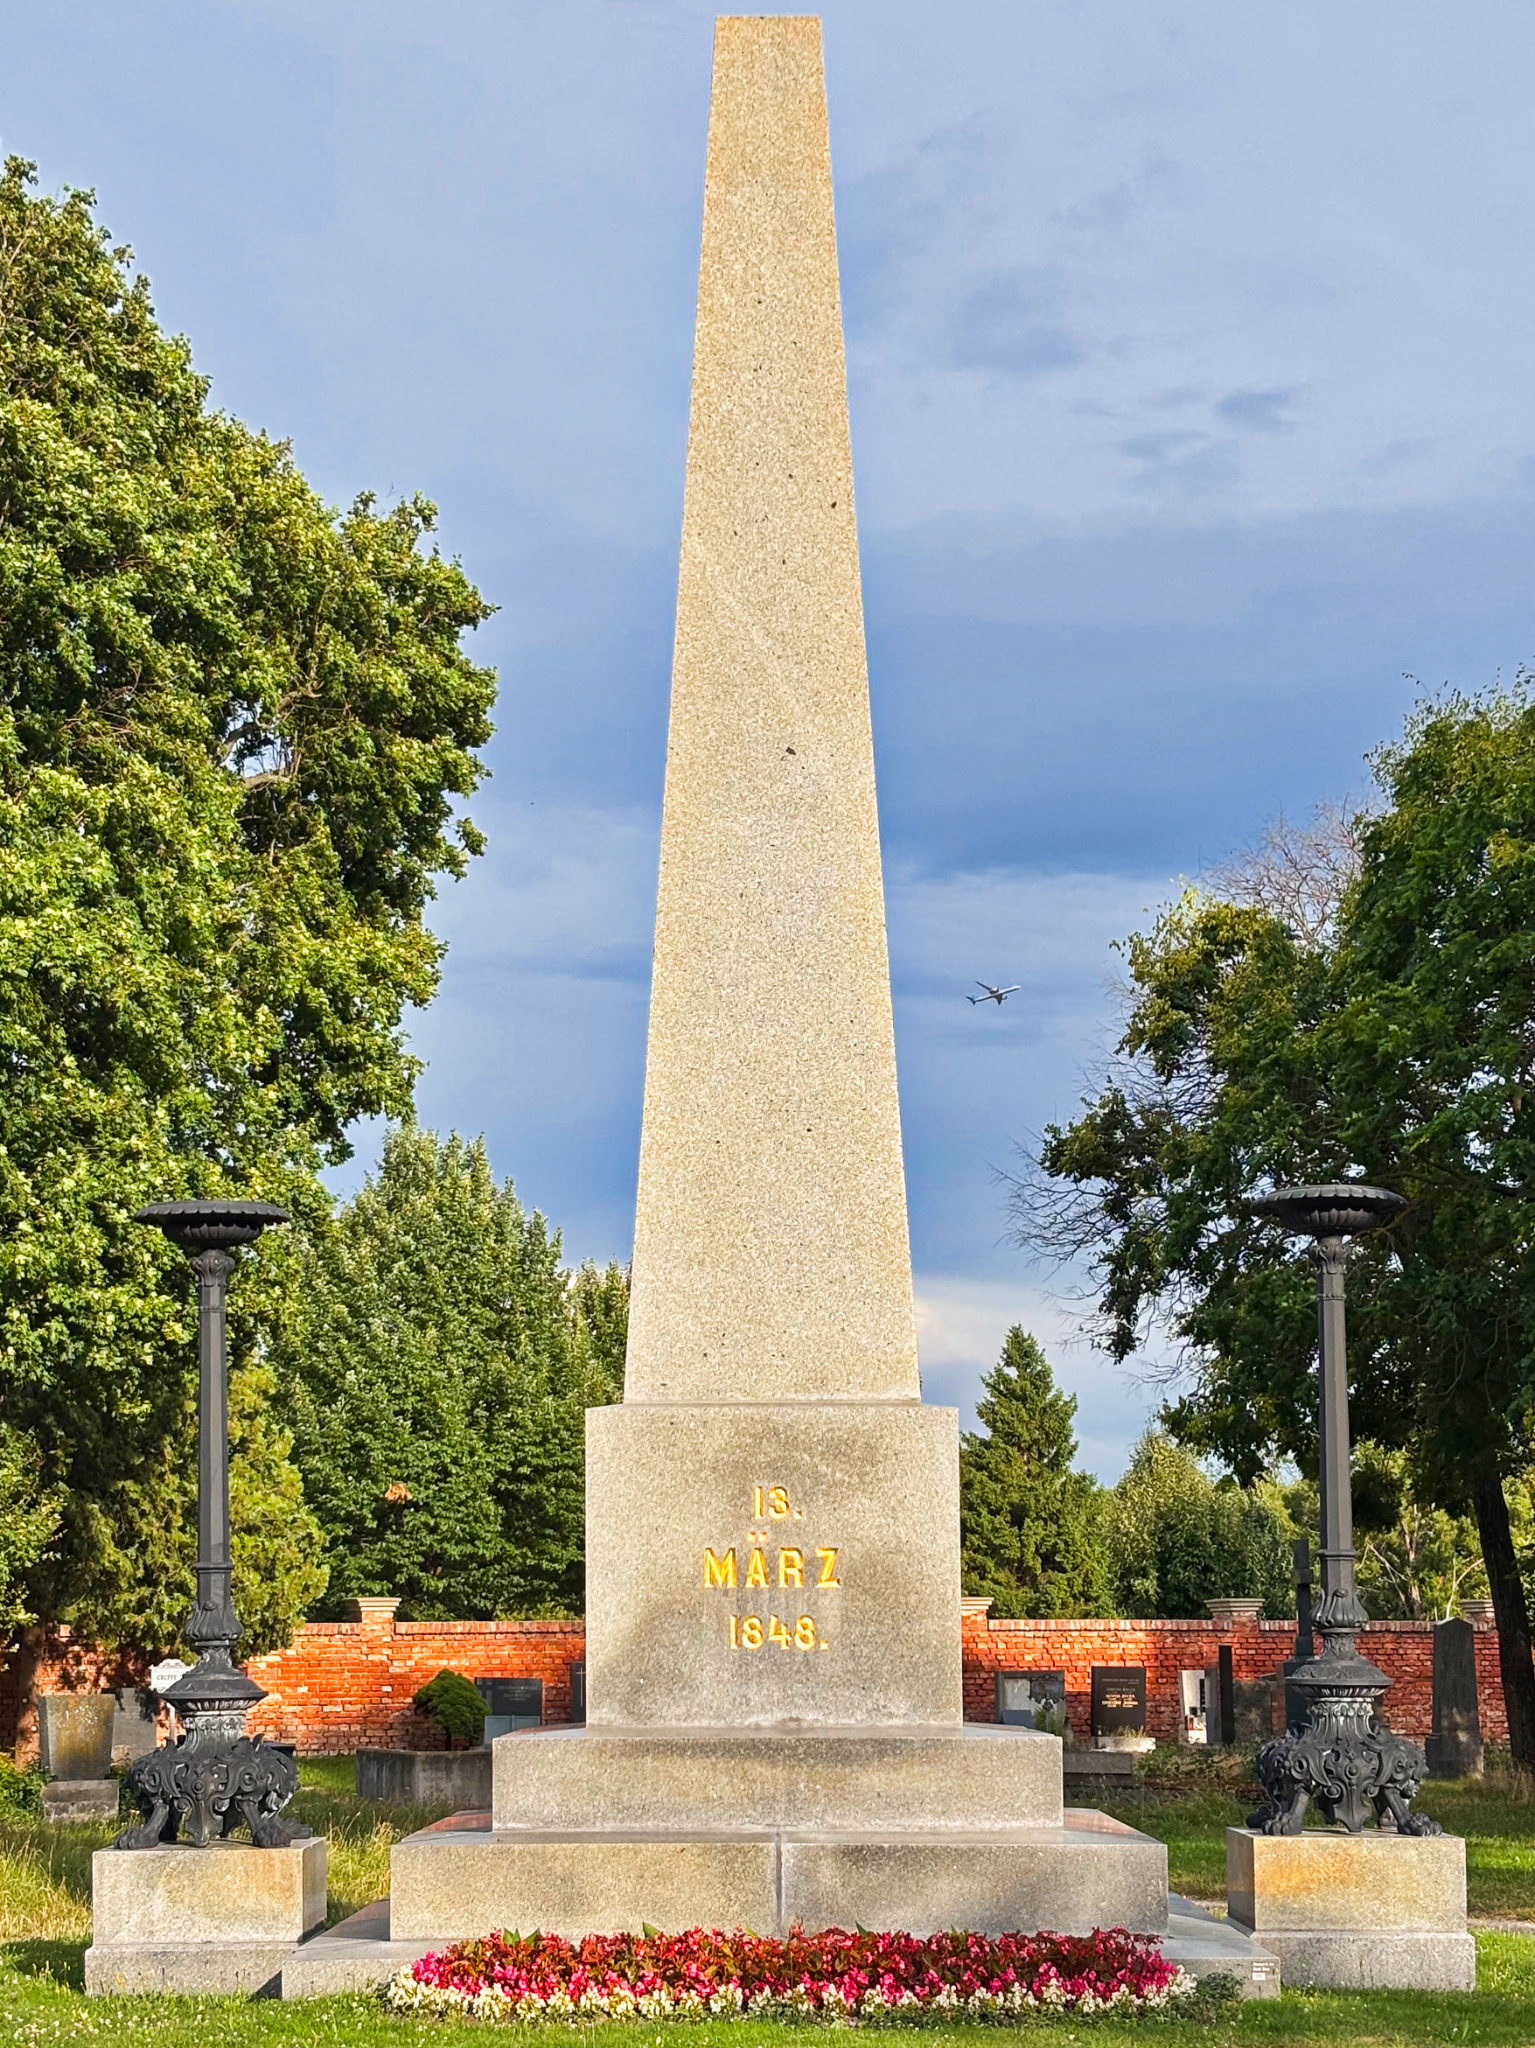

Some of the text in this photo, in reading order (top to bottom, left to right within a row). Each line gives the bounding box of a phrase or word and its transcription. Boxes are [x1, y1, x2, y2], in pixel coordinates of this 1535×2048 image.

[754, 1485, 803, 1520] 13.
[703, 1530, 842, 1589] MÄRZ
[729, 1614, 829, 1651] 1848.
